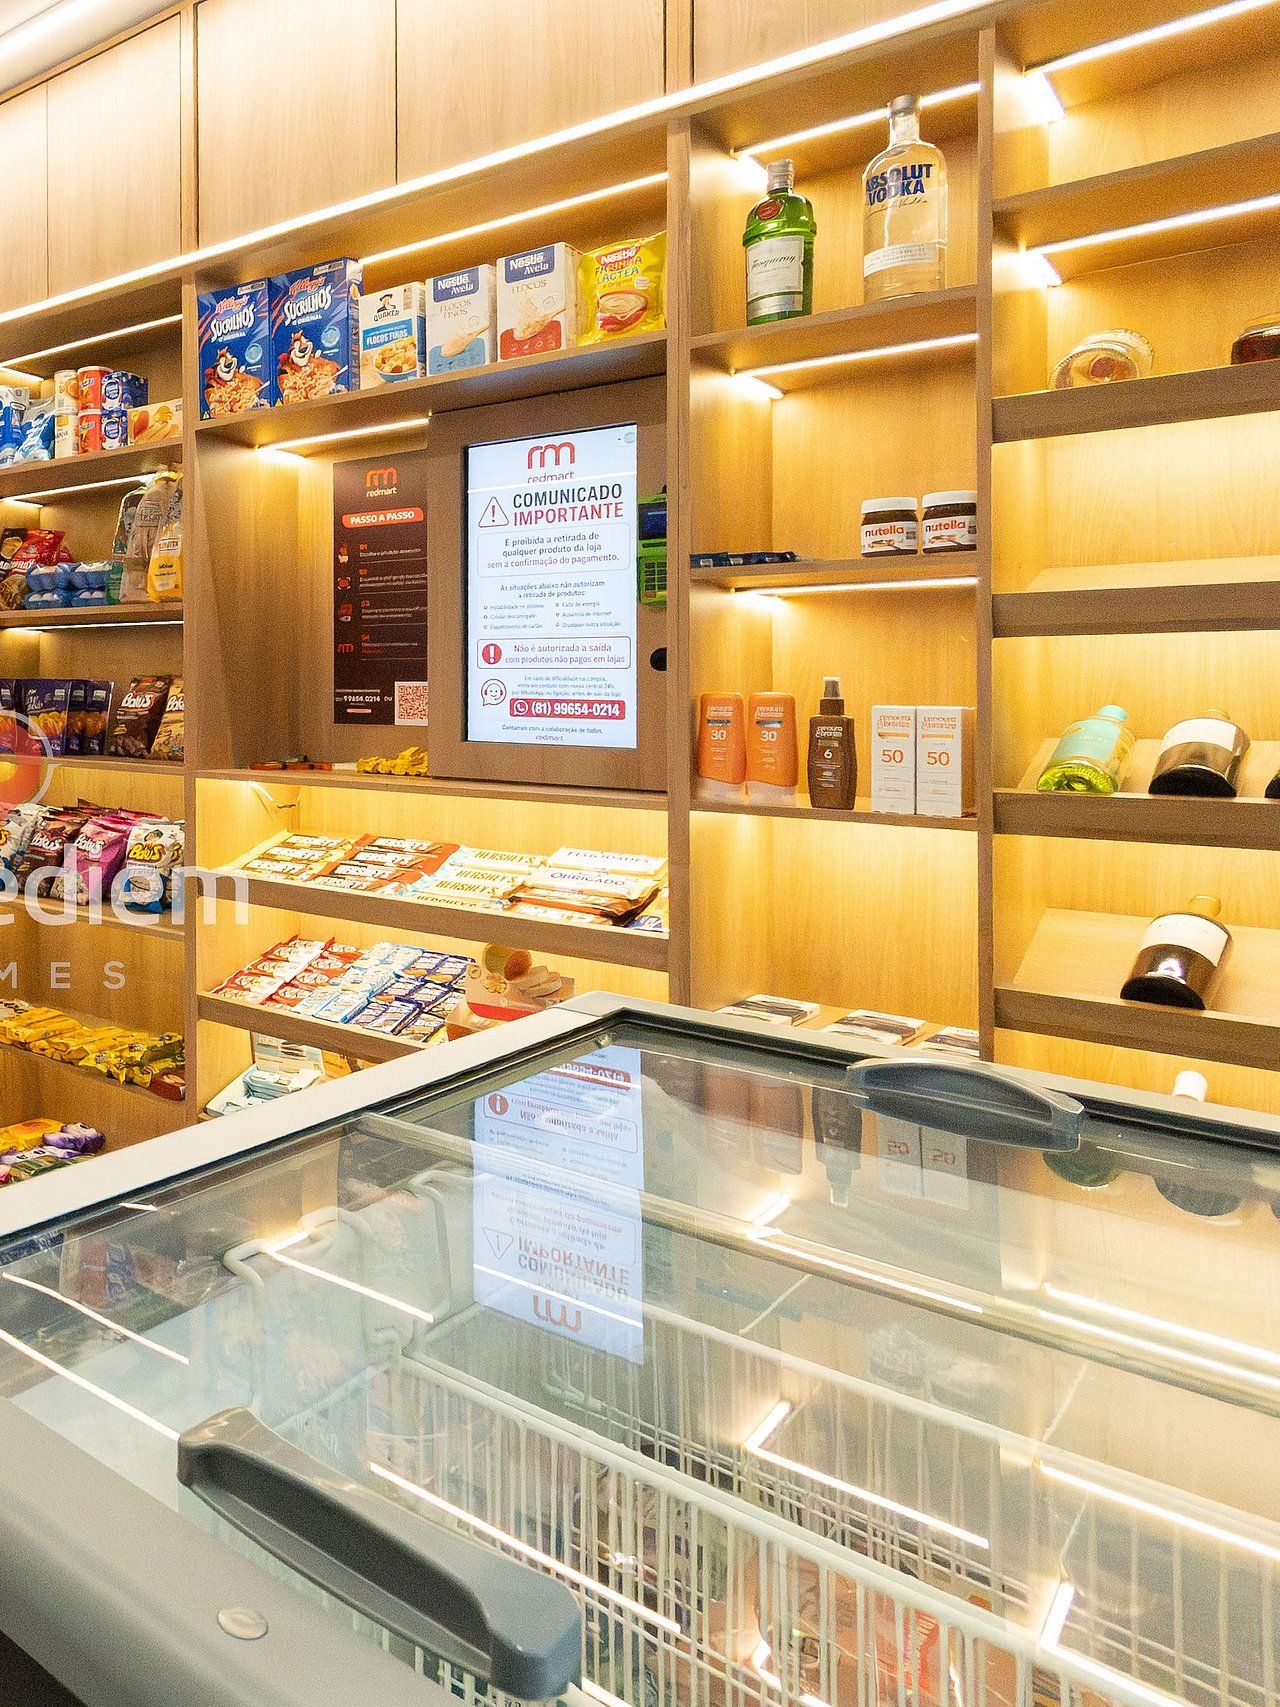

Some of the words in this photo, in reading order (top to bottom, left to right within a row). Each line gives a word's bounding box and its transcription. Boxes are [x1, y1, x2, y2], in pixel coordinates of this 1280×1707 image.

[866, 164, 932, 193] ABSOLUT
[869, 179, 925, 206] VODKA
[284, 284, 332, 326] SUCRILHOS
[210, 303, 255, 342] SUCRILHOS
[373, 310, 400, 322] QUAKER
[528, 472, 574, 483] redmart
[366, 487, 397, 497] redmart
[513, 483, 622, 508] COMUNICADO
[350, 514, 377, 524] PASSO
[386, 511, 414, 520] PASSO
[514, 502, 623, 526] IMPORTANTE
[865, 525, 904, 537] nutella
[925, 520, 966, 532] nutella
[512, 536, 545, 547] proibida
[554, 533, 586, 543] retirada
[588, 532, 599, 540] de
[502, 547, 536, 557] qualquer
[539, 545, 571, 556] produto
[586, 543, 601, 553] loja
[510, 557, 558, 567] confirmação
[559, 556, 570, 564] do
[571, 554, 620, 565] pagamento.
[538, 582, 559, 590] abaixo
[573, 580, 605, 588] autorizam
[514, 644, 529, 652] Não
[589, 643, 612, 652] saída
[521, 656, 553, 665] produtos
[570, 656, 592, 664] pagos
[607, 655, 625, 664] lojas
[531, 701, 552, 716] (81)
[553, 702, 620, 716] 99654-0214
[711, 730, 726, 741] 30
[761, 731, 777, 742] 30
[824, 749, 832, 759] 6
[882, 749, 904, 763] 50
[926, 752, 950, 766] 50
